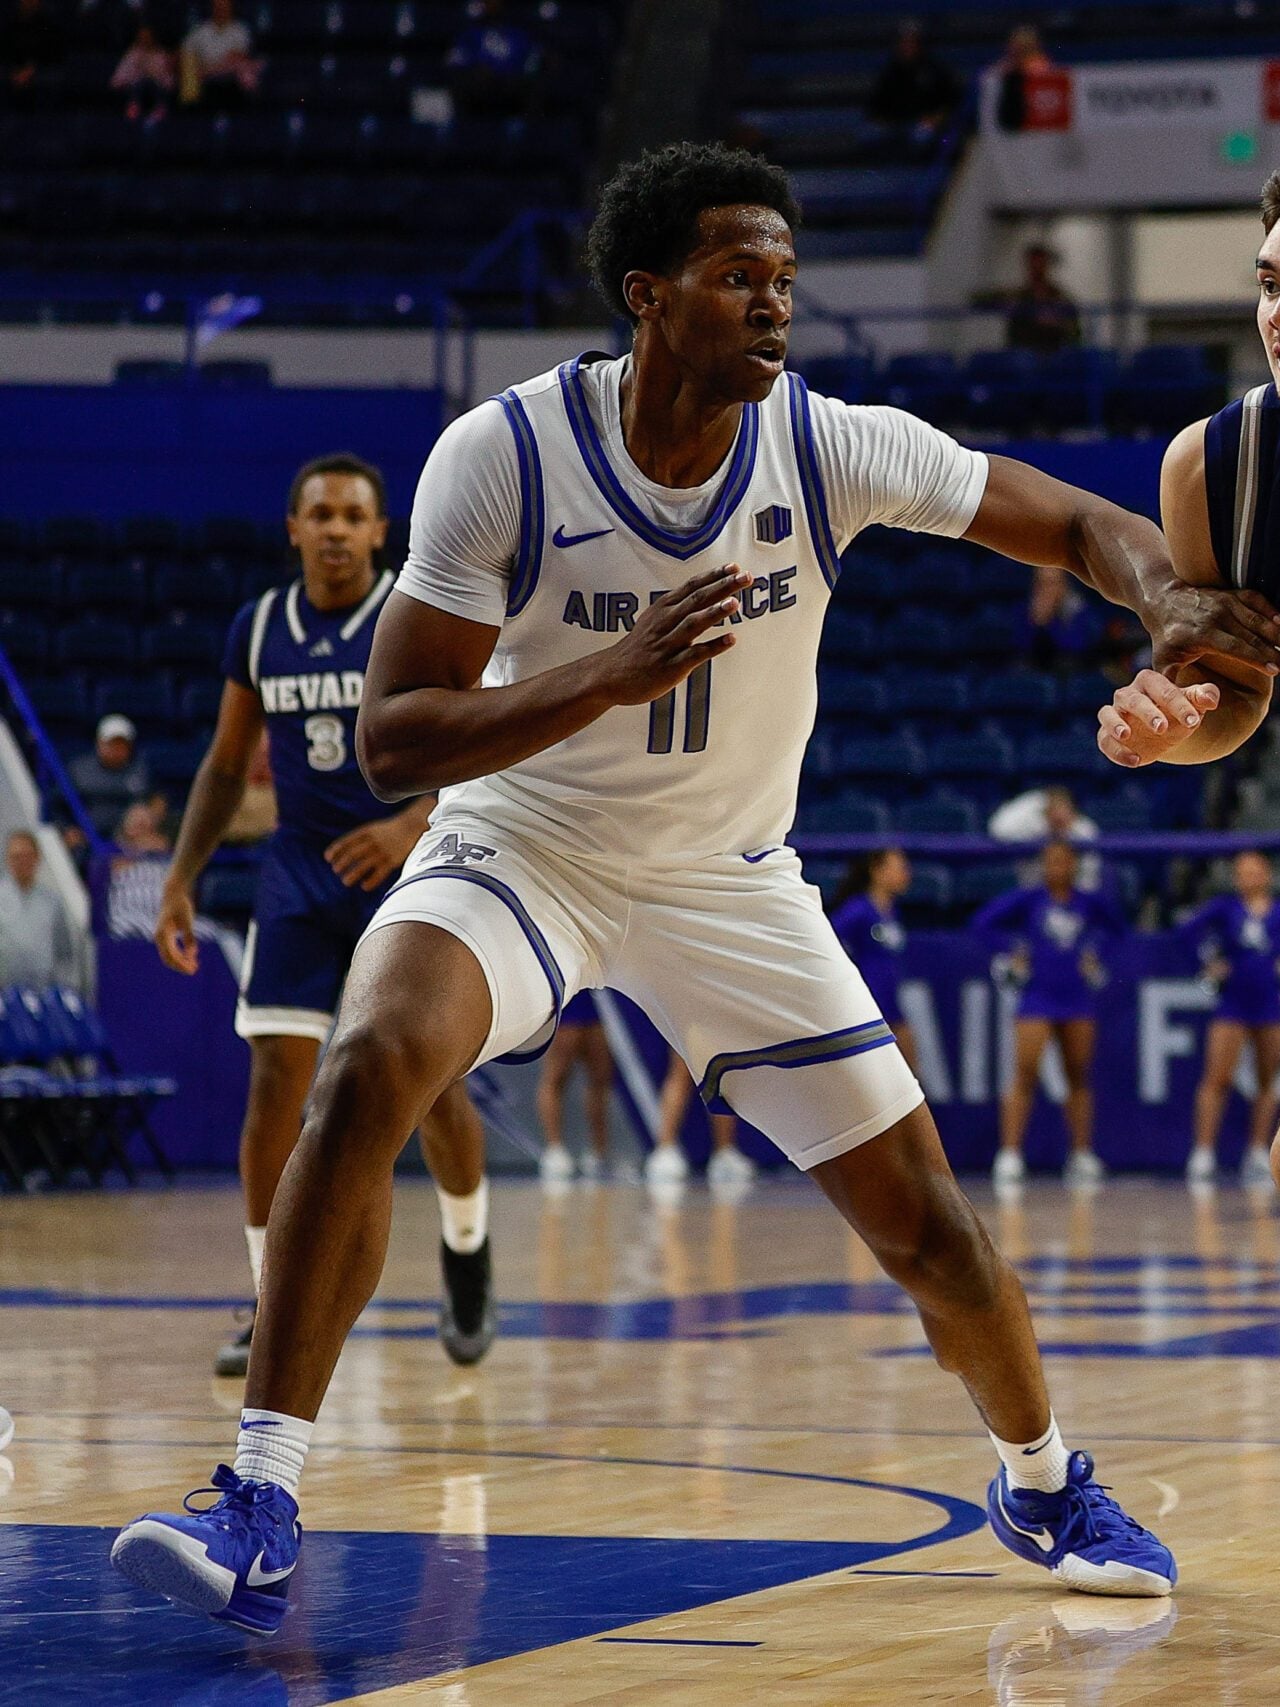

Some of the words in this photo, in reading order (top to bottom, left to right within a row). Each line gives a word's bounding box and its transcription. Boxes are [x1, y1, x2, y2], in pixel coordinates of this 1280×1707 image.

[562, 590, 639, 632] AIR
[259, 670, 366, 714] NEVAD
[647, 658, 712, 754] 11
[304, 713, 347, 772] 3
[419, 832, 498, 864] AF
